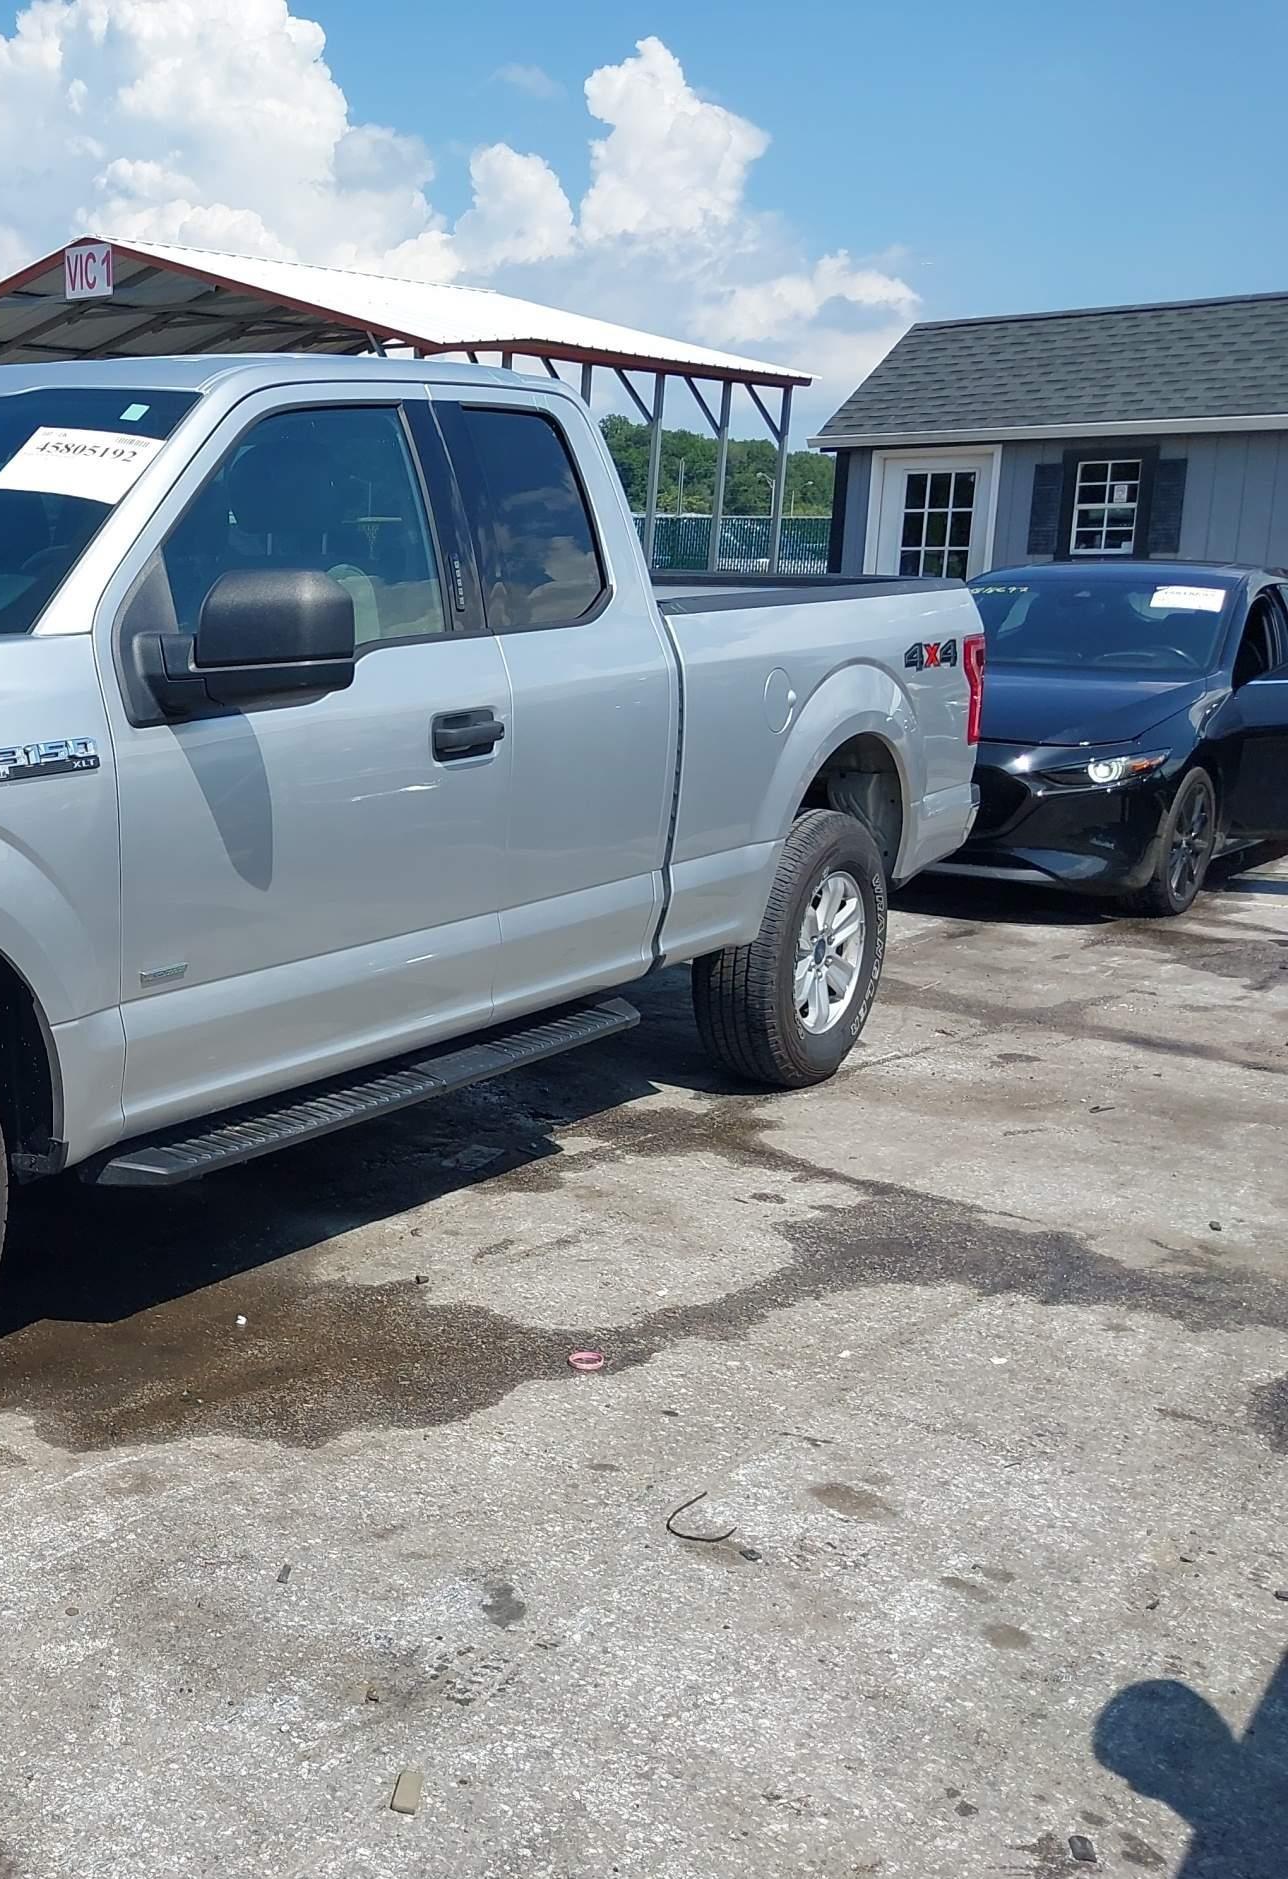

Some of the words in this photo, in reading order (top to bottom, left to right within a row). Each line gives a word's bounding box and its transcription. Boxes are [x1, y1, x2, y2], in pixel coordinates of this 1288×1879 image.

[67, 251, 97, 291] VIC
[101, 250, 111, 287] 1
[36, 441, 138, 463] 45805192
[72, 758, 97, 769] XLT
[851, 873, 886, 1036] WRANGLER
